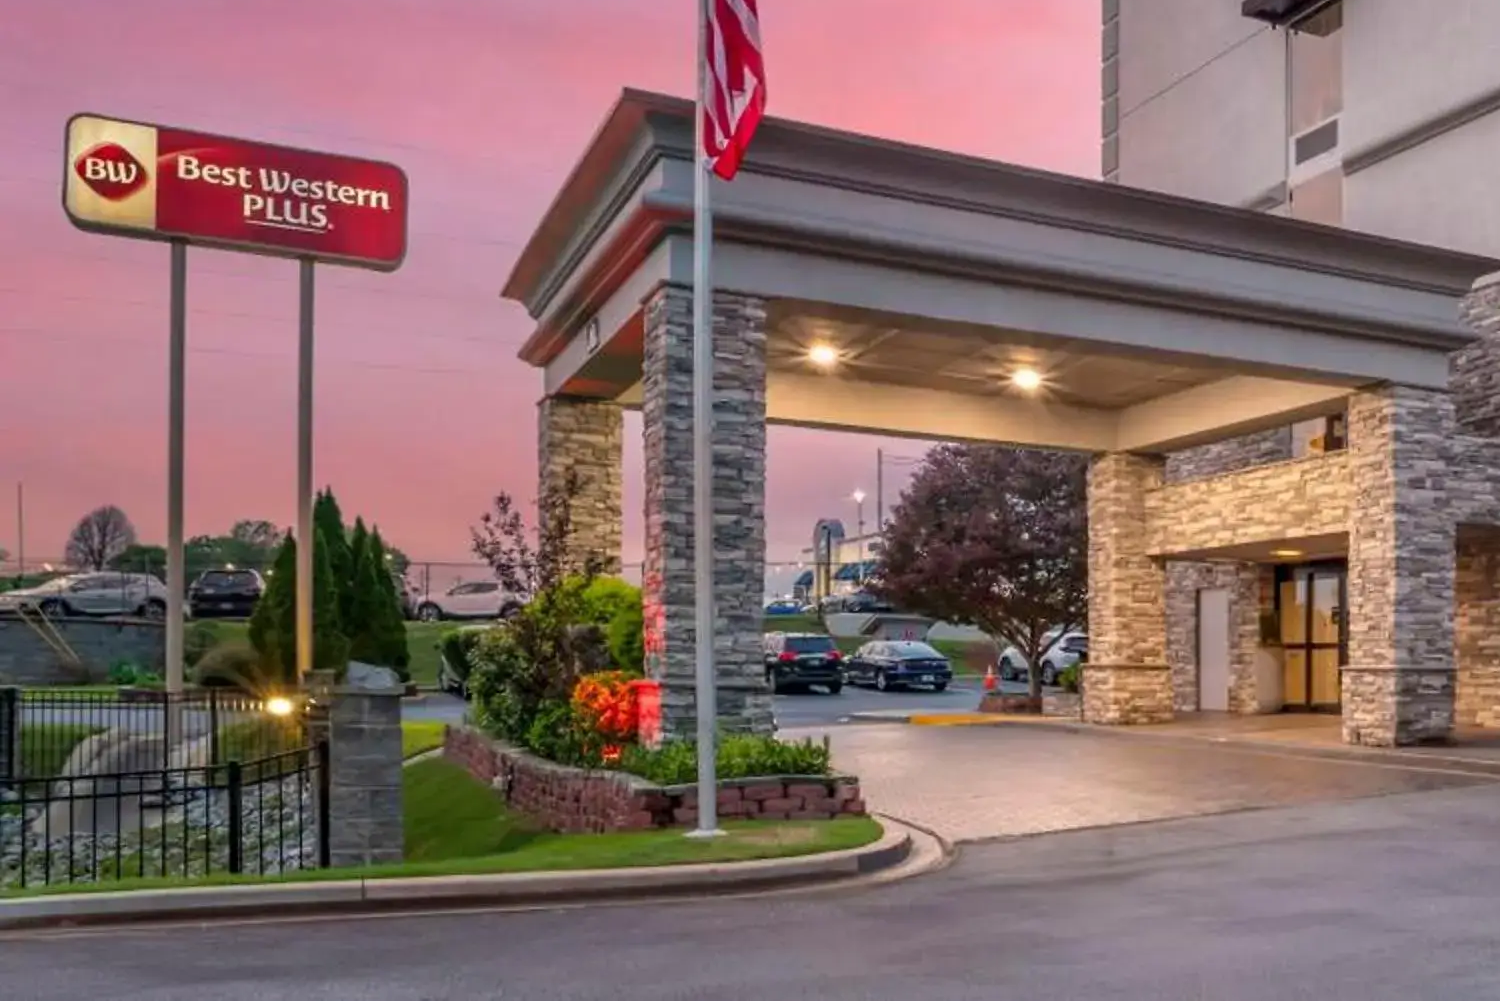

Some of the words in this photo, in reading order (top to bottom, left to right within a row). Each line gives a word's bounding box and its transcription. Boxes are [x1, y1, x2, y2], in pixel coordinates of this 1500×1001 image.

[85, 157, 137, 184] BW
[177, 155, 253, 188] Best
[259, 168, 390, 210] Western
[243, 194, 328, 228] PLUS
